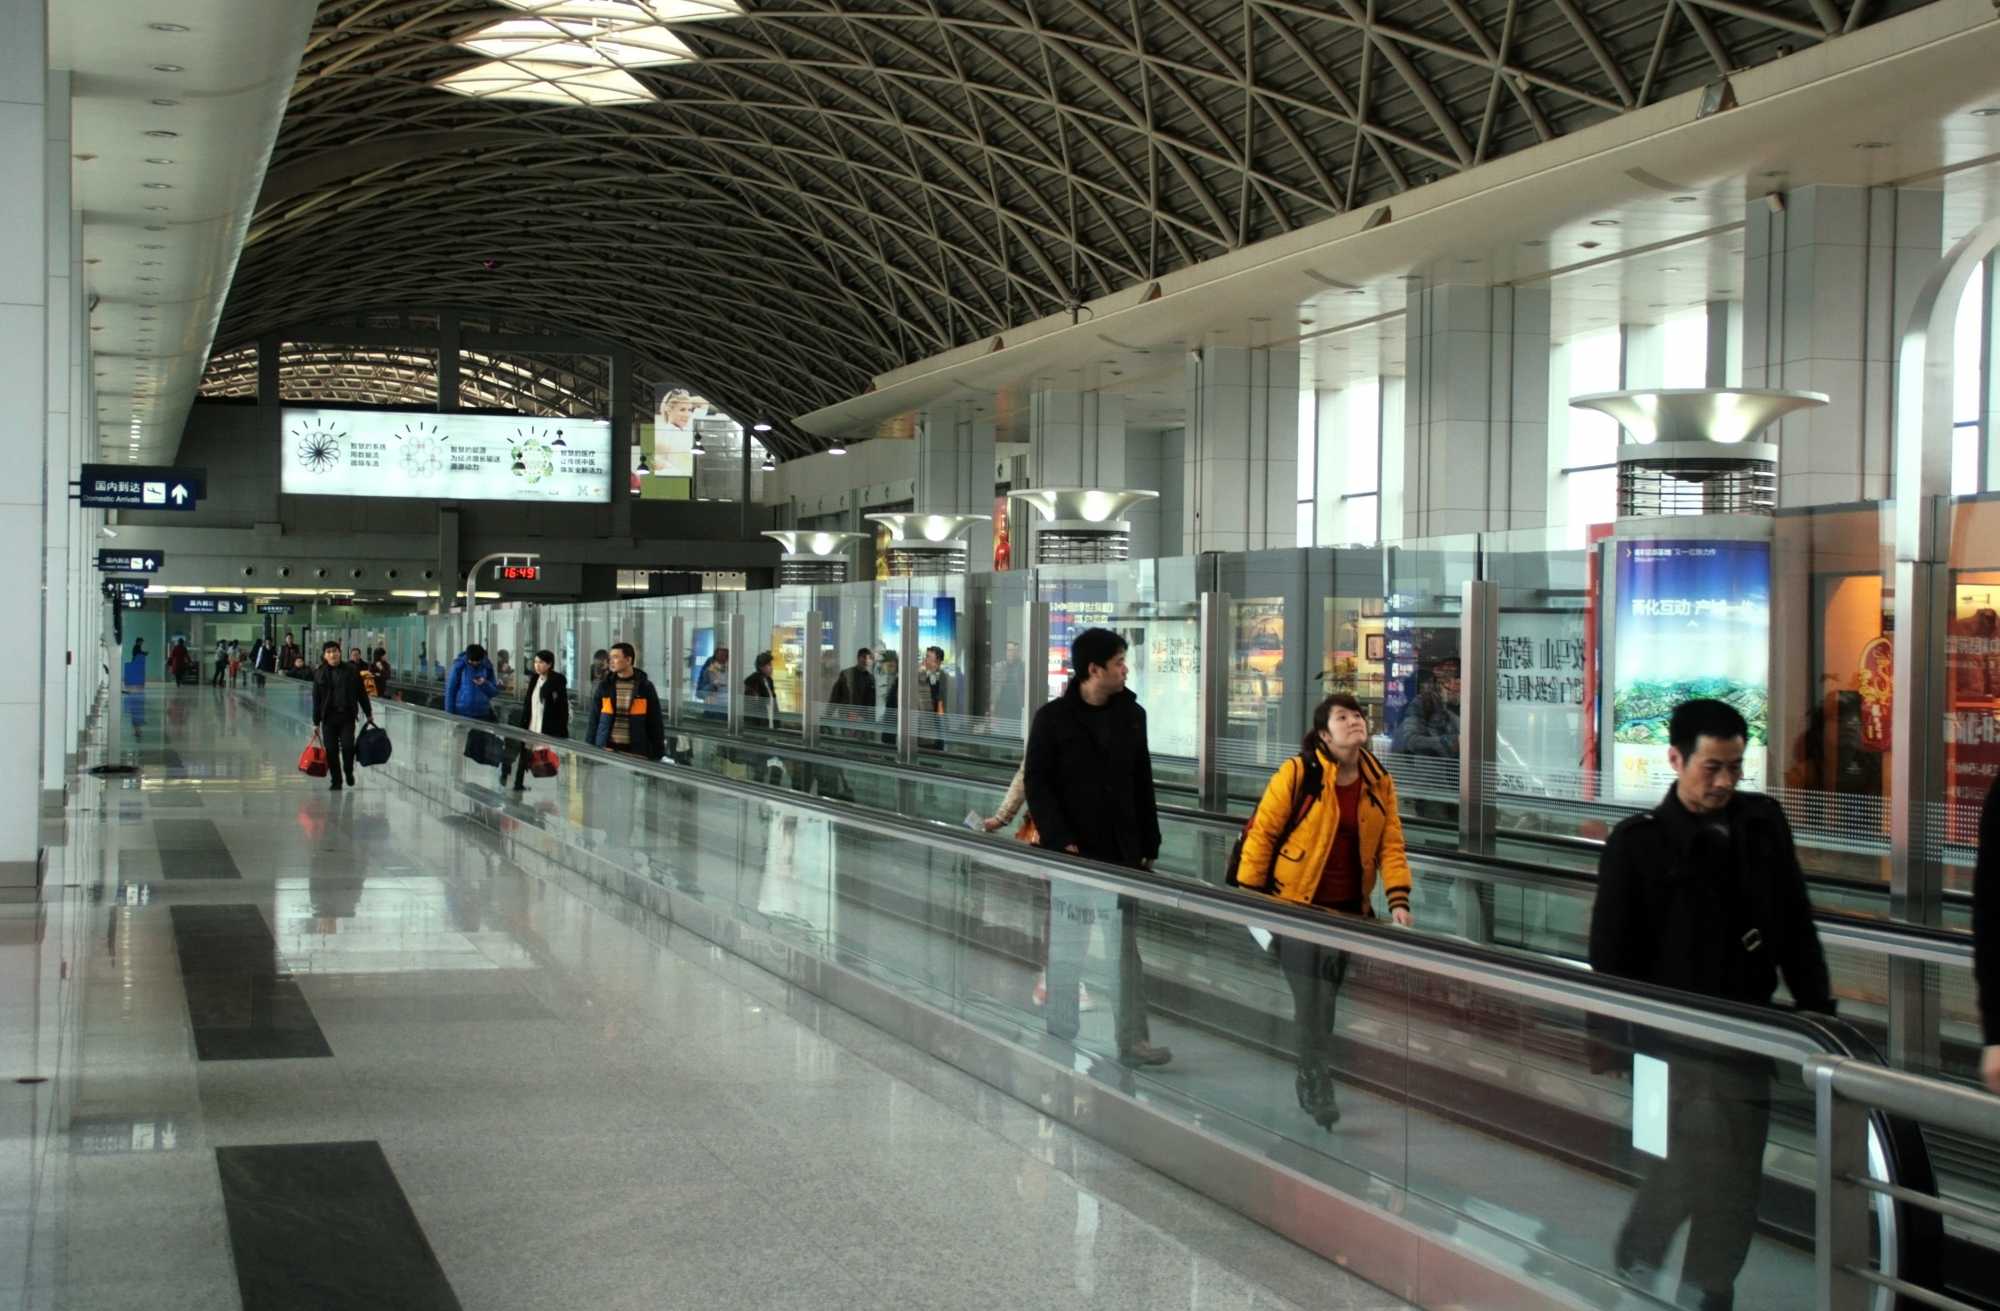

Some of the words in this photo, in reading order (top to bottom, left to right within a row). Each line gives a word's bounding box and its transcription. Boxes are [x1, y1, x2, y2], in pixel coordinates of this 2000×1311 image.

[95, 481, 140, 493] 国内到达
[504, 566, 535, 579] 16:49
